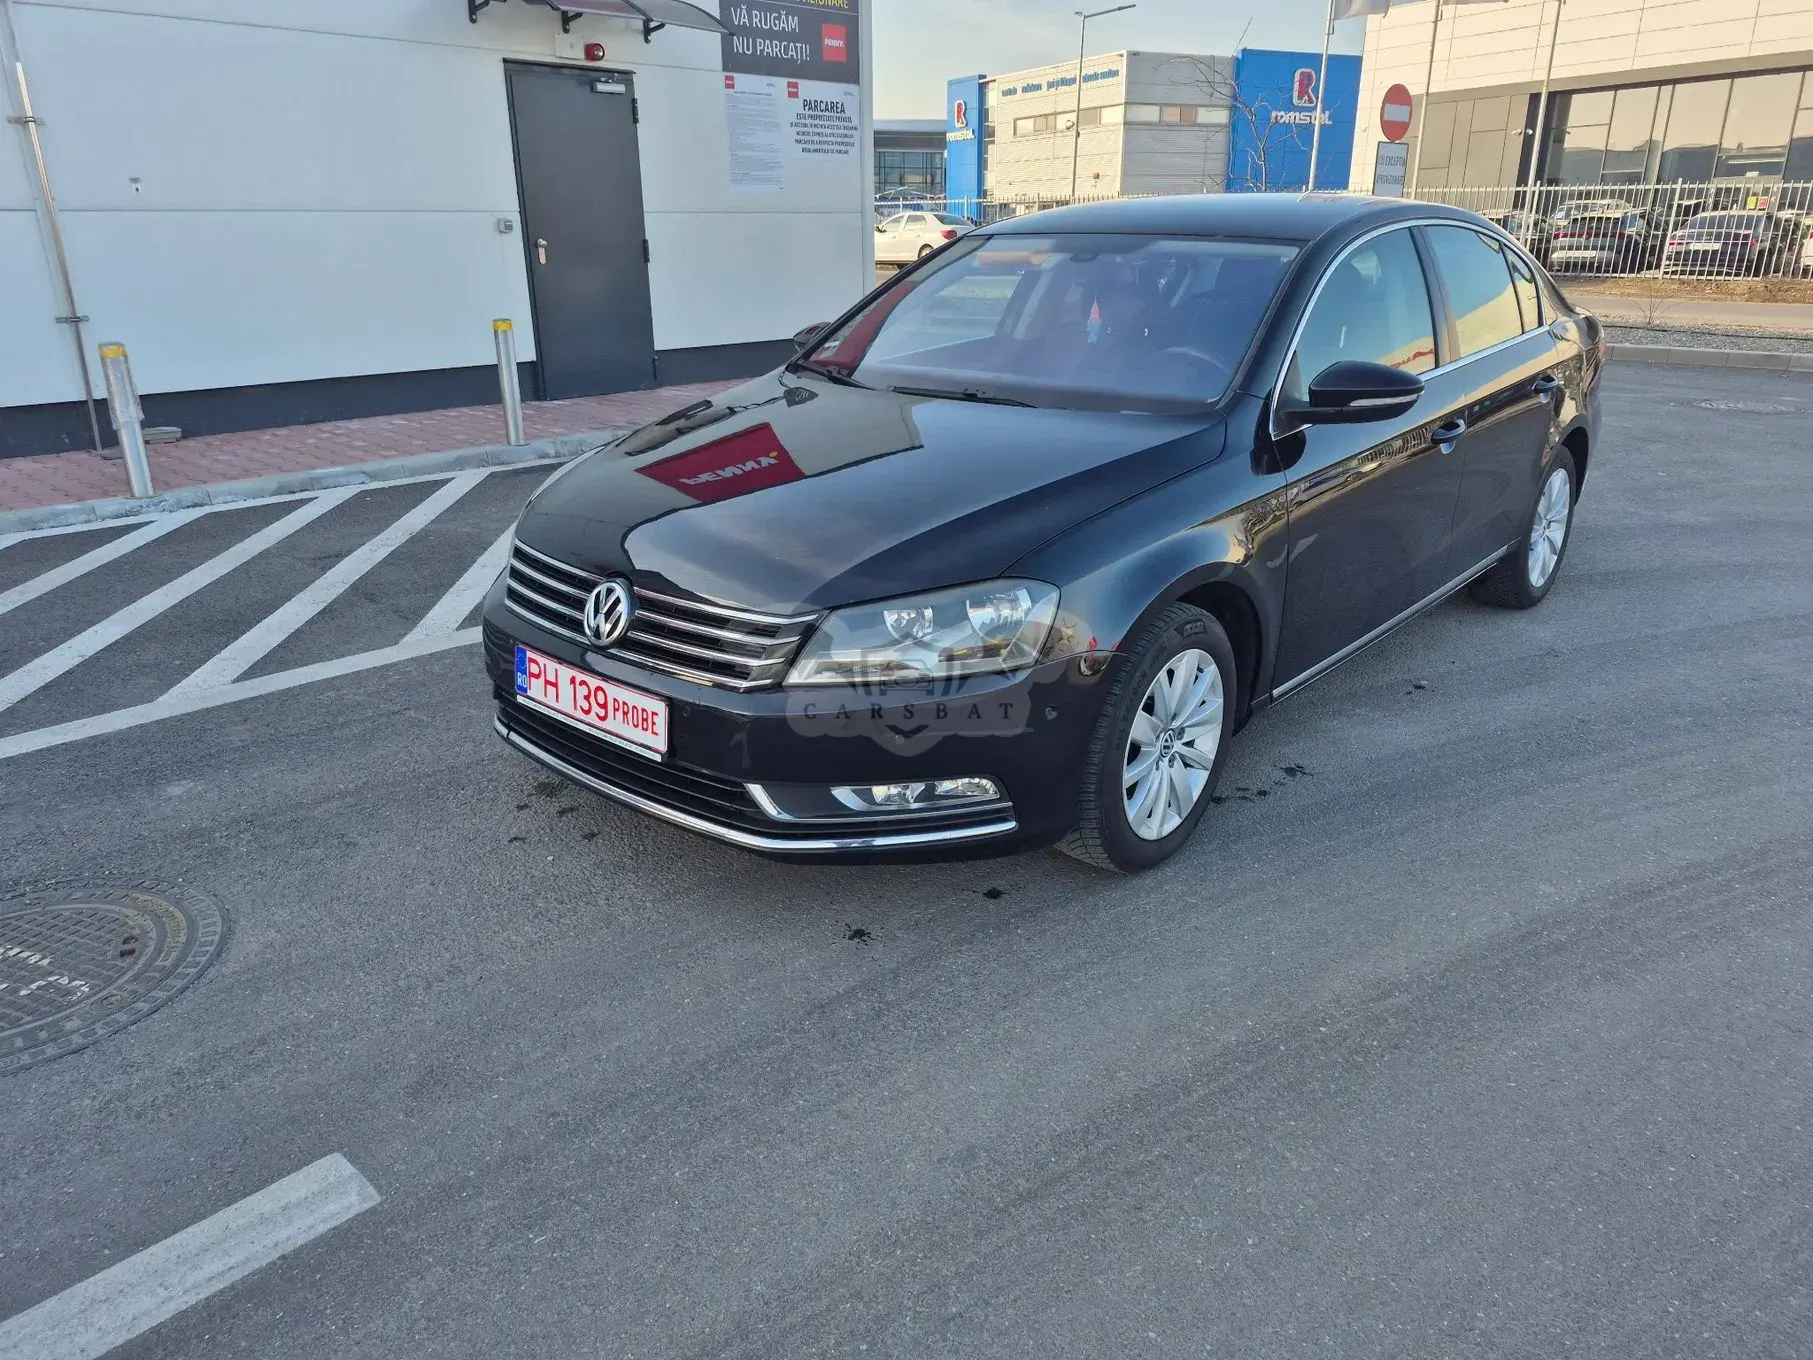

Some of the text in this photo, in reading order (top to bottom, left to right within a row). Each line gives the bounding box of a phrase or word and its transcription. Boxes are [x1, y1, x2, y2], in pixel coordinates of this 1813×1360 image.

[731, 4, 799, 33] VĂ RUGĂM
[733, 35, 752, 54] NU
[803, 99, 846, 114] PARCAREA
[517, 672, 527, 688] RO
[528, 656, 560, 703] PH
[569, 675, 609, 722] 139
[613, 697, 659, 736] PROBE
